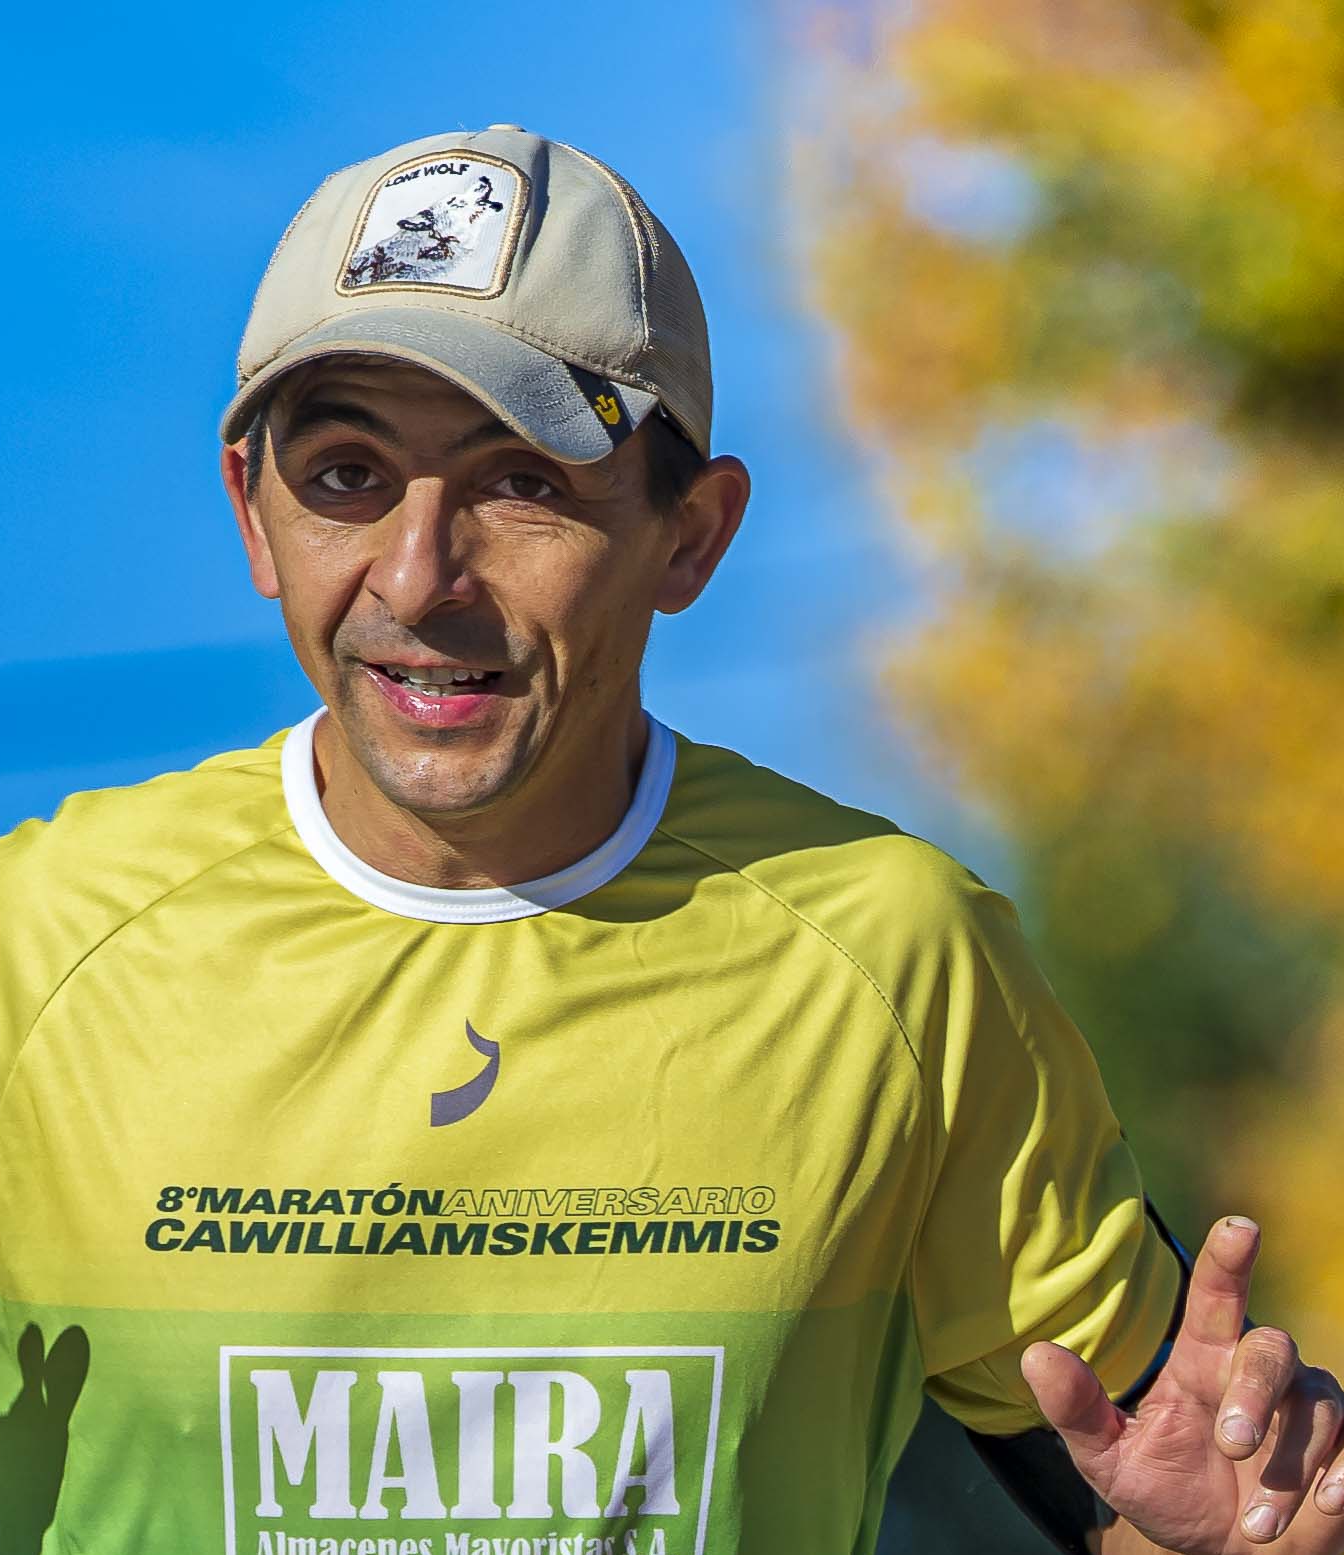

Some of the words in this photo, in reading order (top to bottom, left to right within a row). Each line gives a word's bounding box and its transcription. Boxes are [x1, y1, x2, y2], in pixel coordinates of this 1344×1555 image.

[385, 169, 421, 187] LONE
[424, 163, 470, 176] WOLF
[145, 1220, 781, 1255] CAWILLIAMSKEMMIS
[250, 1369, 681, 1520] MAIRA
